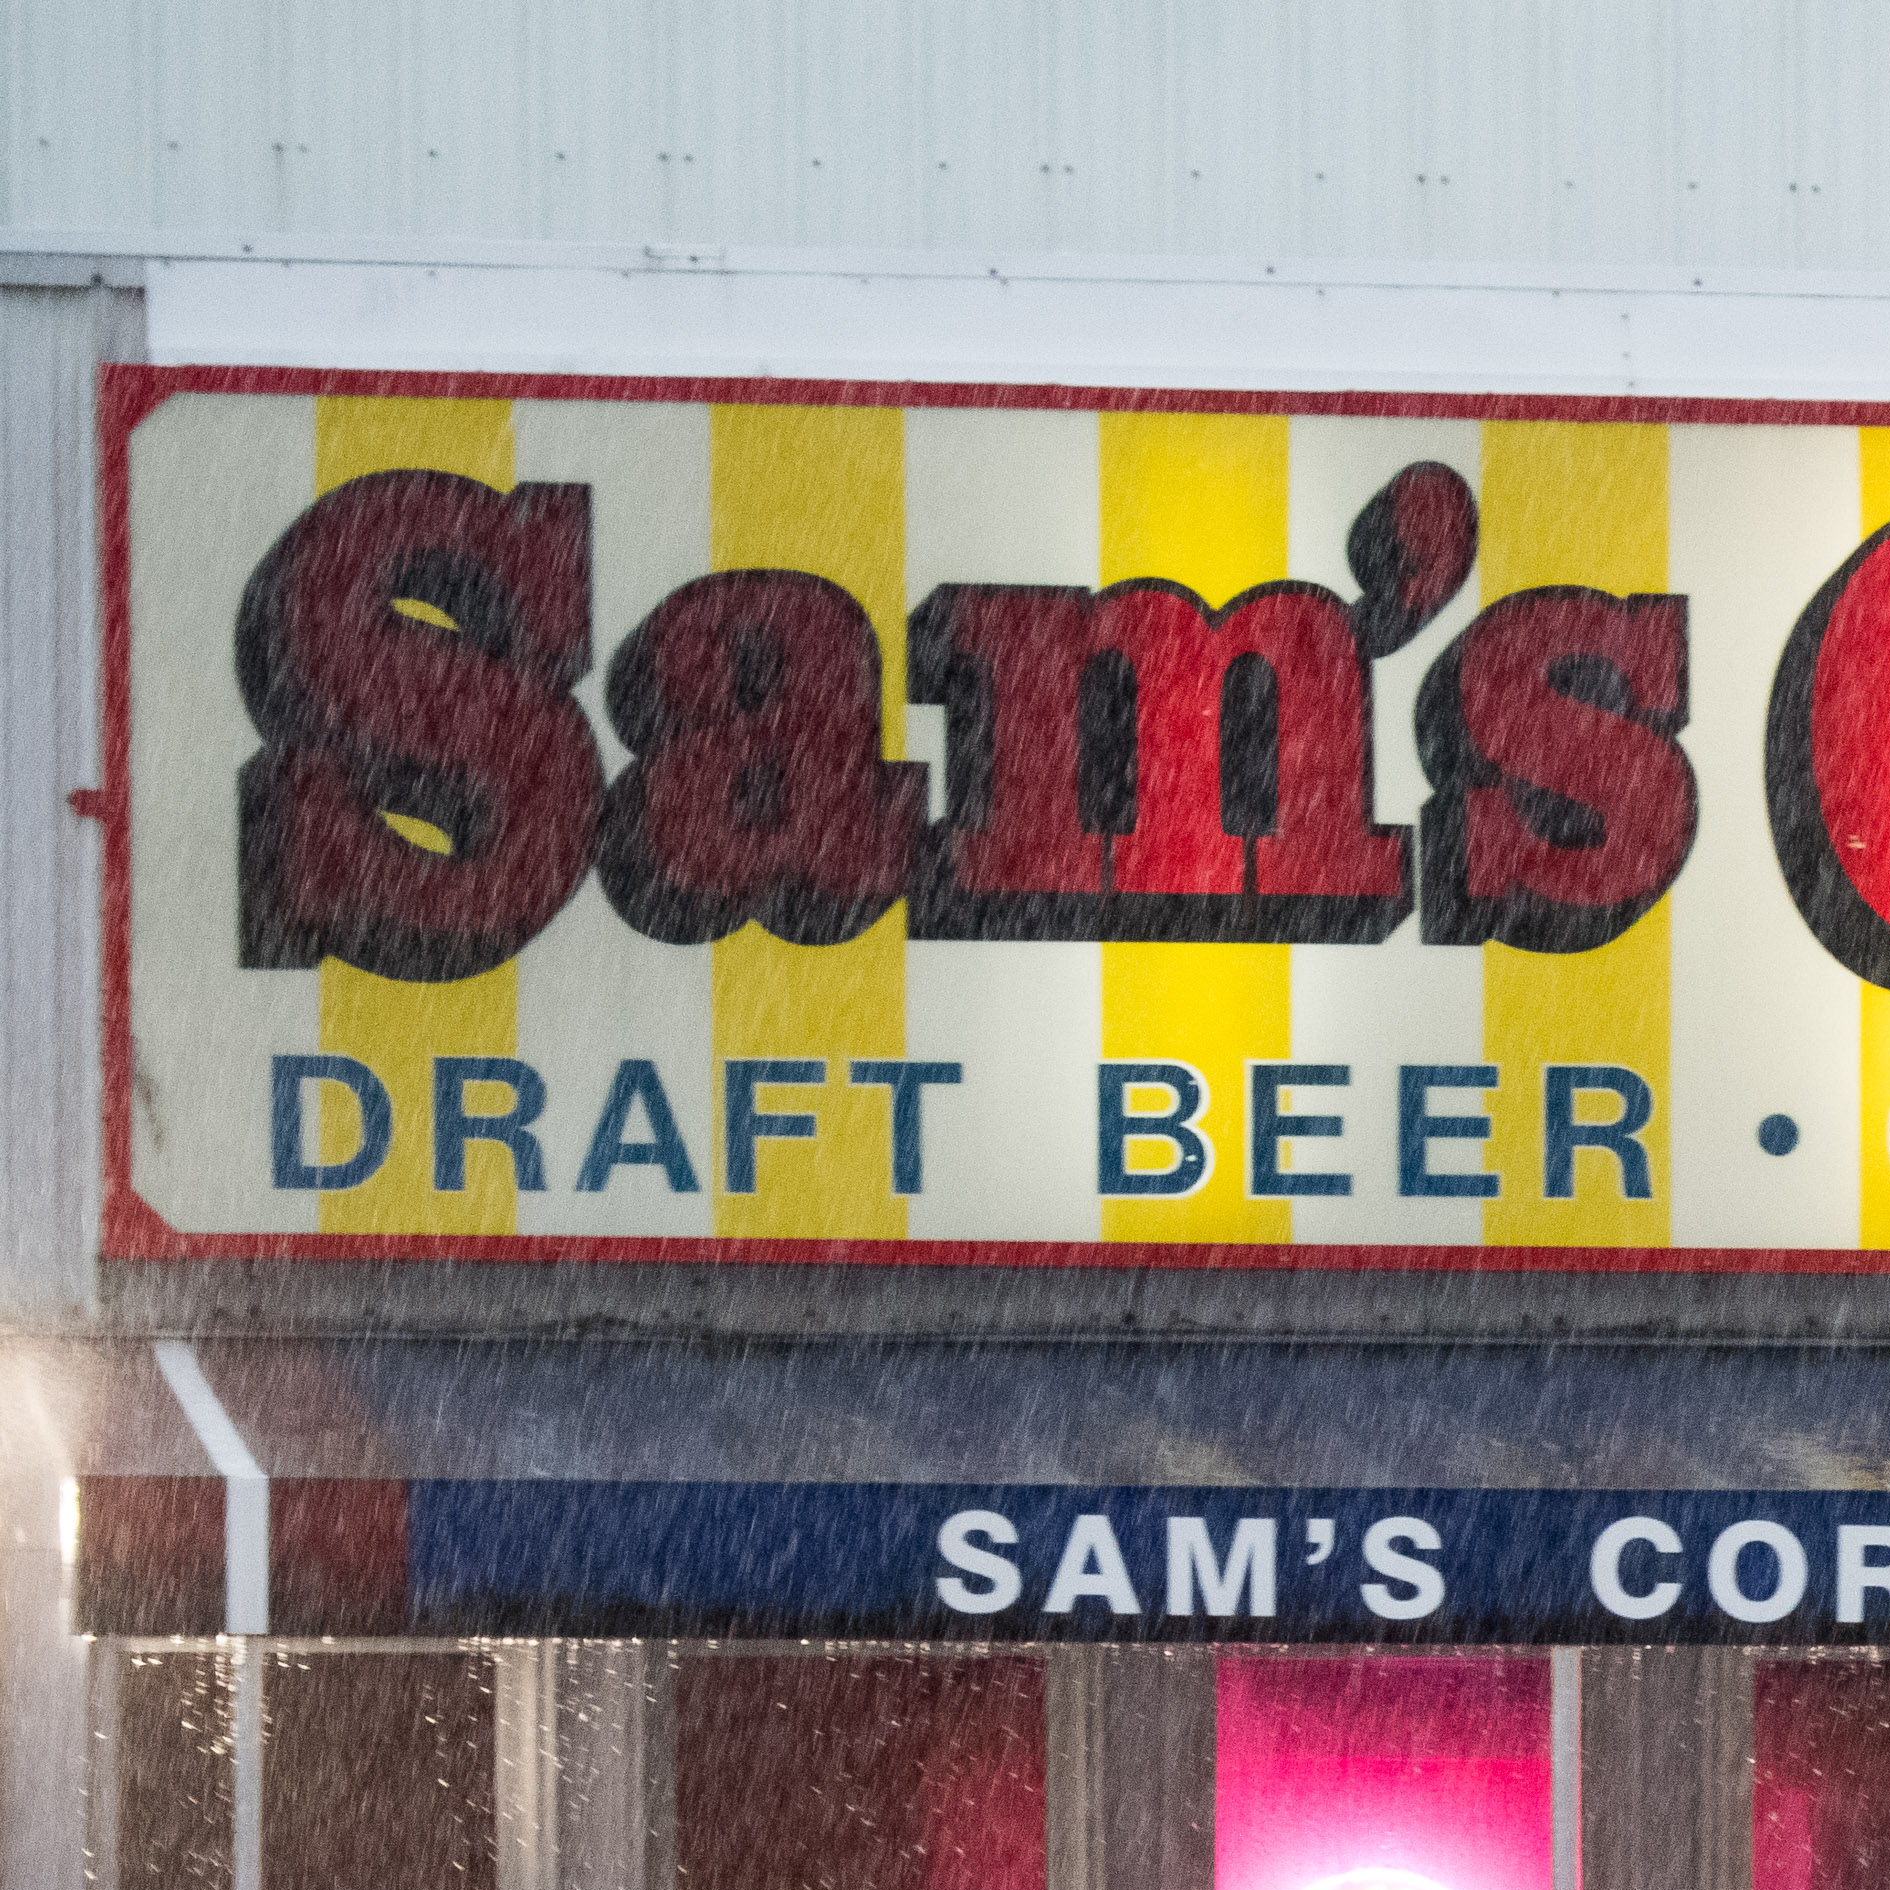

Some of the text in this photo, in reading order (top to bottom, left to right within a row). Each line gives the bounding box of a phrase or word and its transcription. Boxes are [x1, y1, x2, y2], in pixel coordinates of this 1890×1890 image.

[235, 461, 1698, 982] Sam's
[268, 1053, 964, 1196] DRAFT
[1097, 1061, 1656, 1200] BEER
[934, 1508, 1447, 1618] SAM'S
